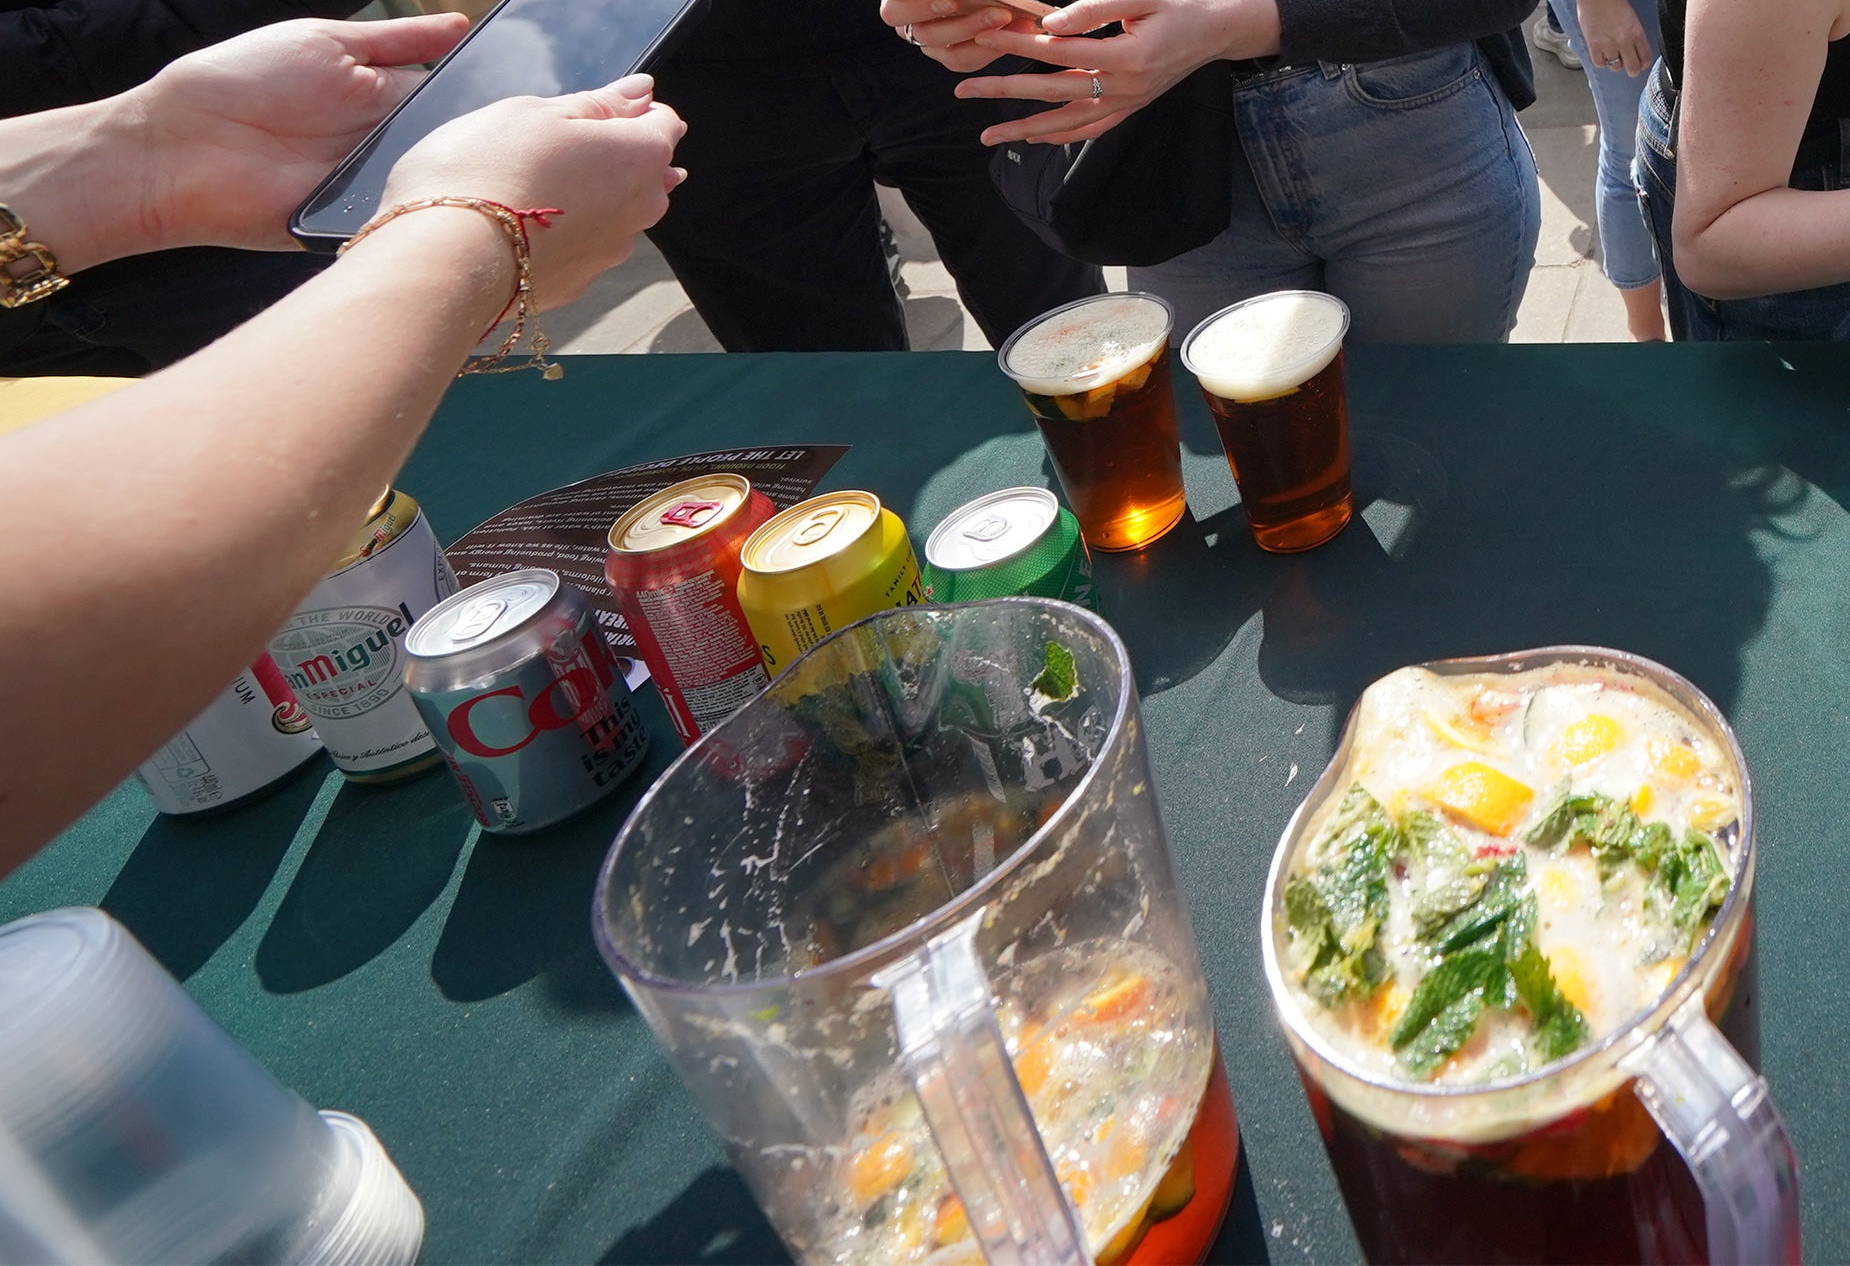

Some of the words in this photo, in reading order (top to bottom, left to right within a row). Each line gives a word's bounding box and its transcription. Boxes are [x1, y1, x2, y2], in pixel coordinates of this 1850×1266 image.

[740, 451, 776, 461] THE
[774, 450, 806, 461] LET
[503, 549, 555, 558] producing
[556, 552, 580, 561] food,
[300, 612, 329, 626] THE
[339, 610, 391, 626] WORLD
[306, 678, 377, 700] ESPECIAL
[311, 703, 349, 717] SINCE
[353, 688, 390, 712] 1890
